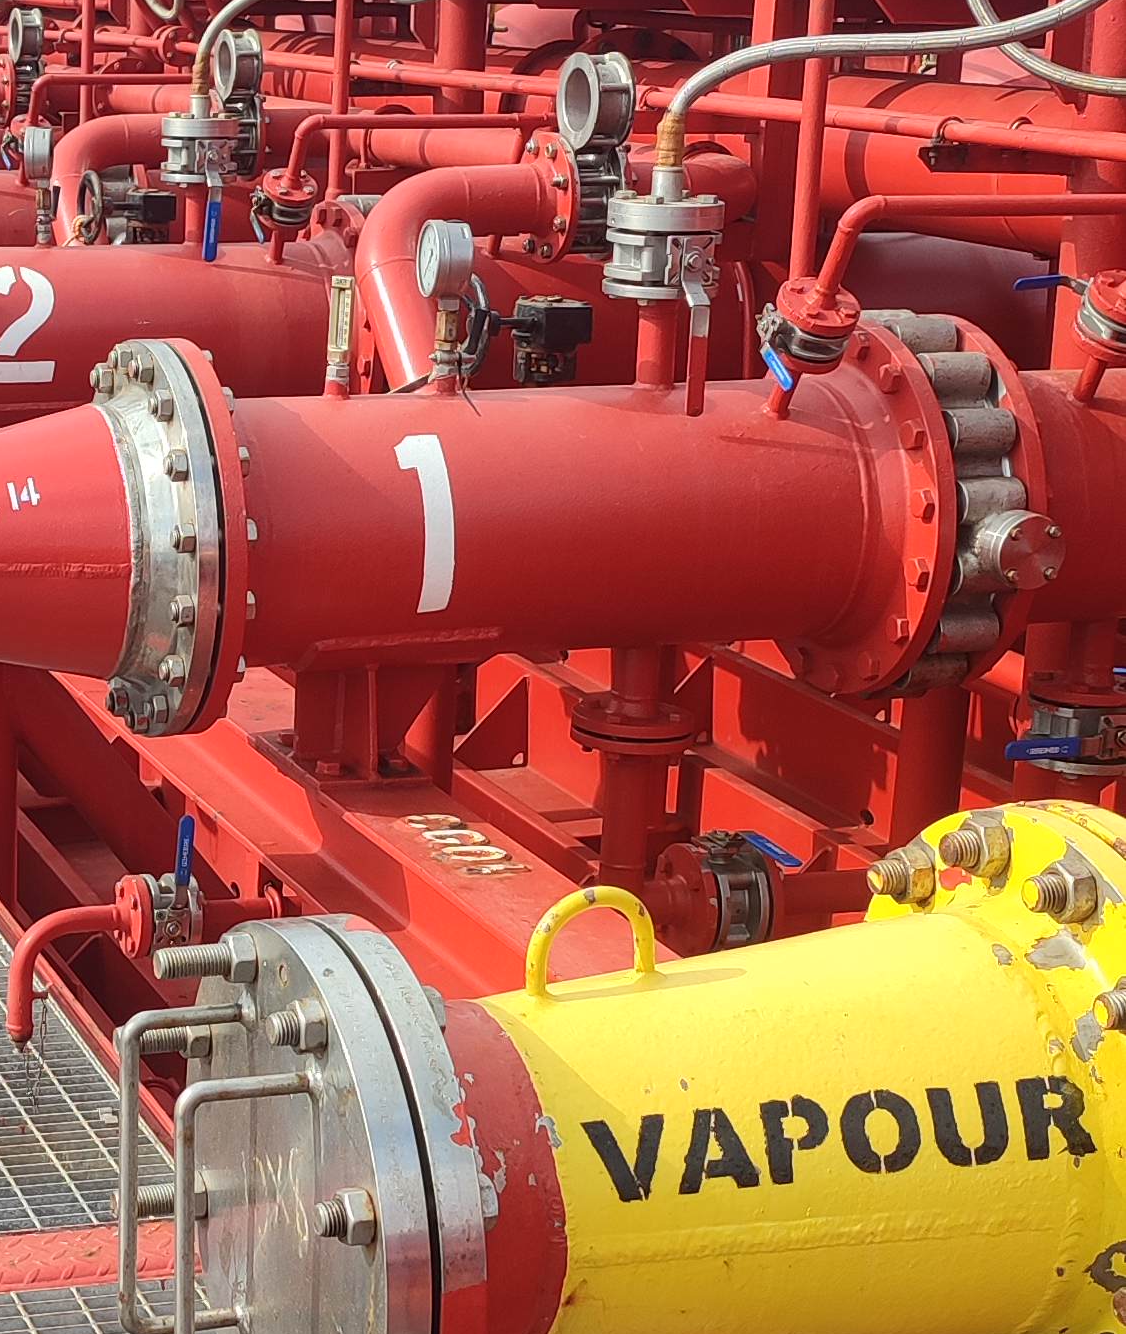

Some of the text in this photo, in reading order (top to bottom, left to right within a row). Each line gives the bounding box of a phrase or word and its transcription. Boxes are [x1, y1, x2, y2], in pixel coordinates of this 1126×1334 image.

[6, 477, 41, 511] 14
[393, 434, 455, 614] 1
[581, 1075, 1097, 1203] VAPOUR
